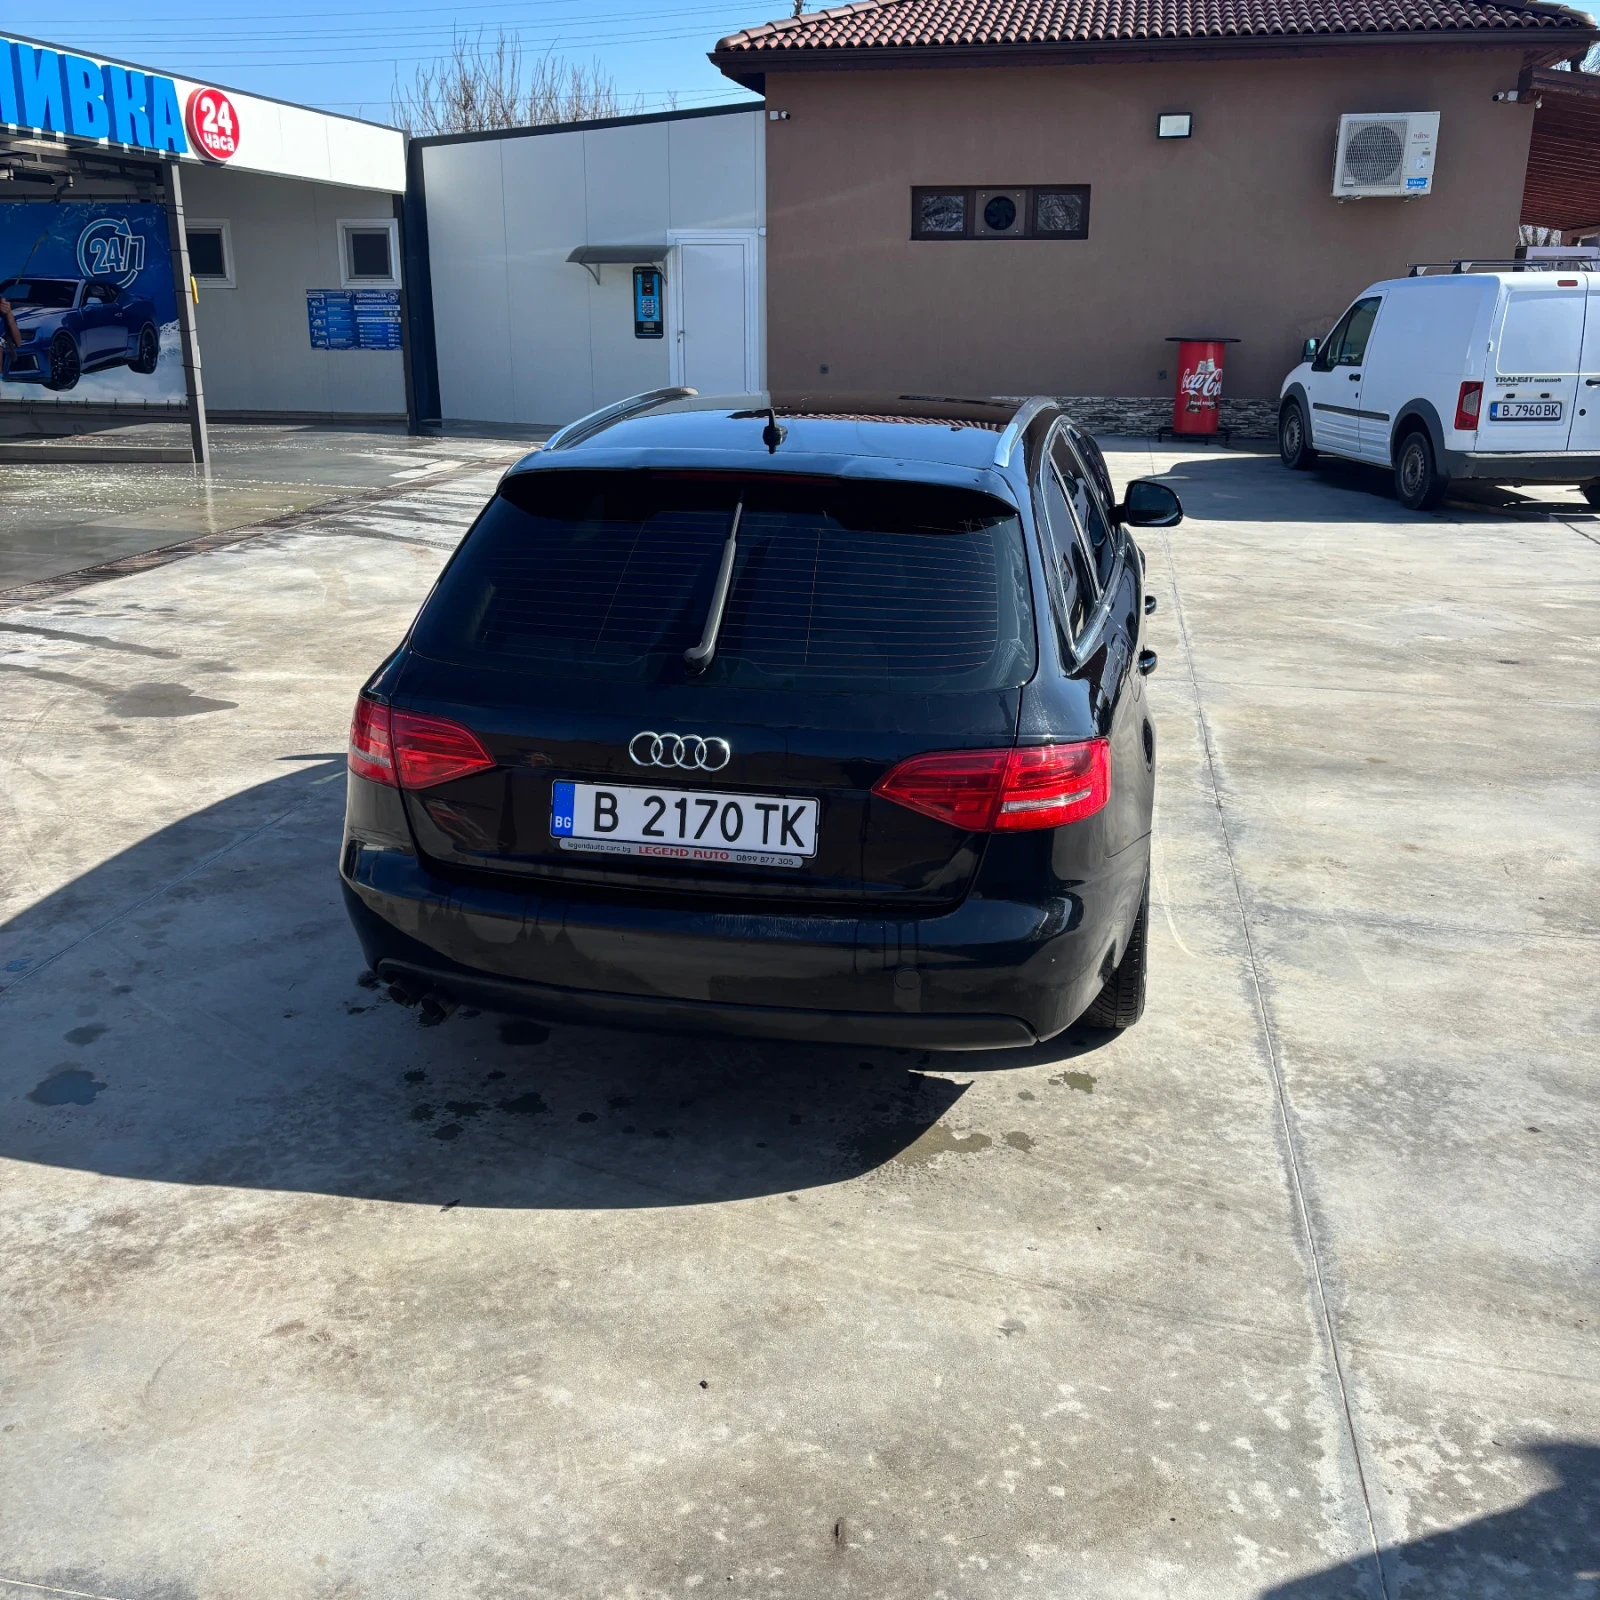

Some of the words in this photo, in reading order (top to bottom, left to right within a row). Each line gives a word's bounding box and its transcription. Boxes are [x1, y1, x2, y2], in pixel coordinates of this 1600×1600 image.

[201, 97, 233, 136] 24
[203, 131, 235, 153] часа
[90, 235, 146, 275] 24/7
[554, 815, 572, 829] BG
[593, 791, 619, 833] B
[641, 795, 744, 843] 2170
[754, 803, 807, 848] TK
[638, 845, 689, 858] LEGEND
[693, 849, 730, 861] AUTO
[736, 854, 758, 863] 0899
[760, 856, 775, 864] 877
[777, 858, 794, 866] 305
